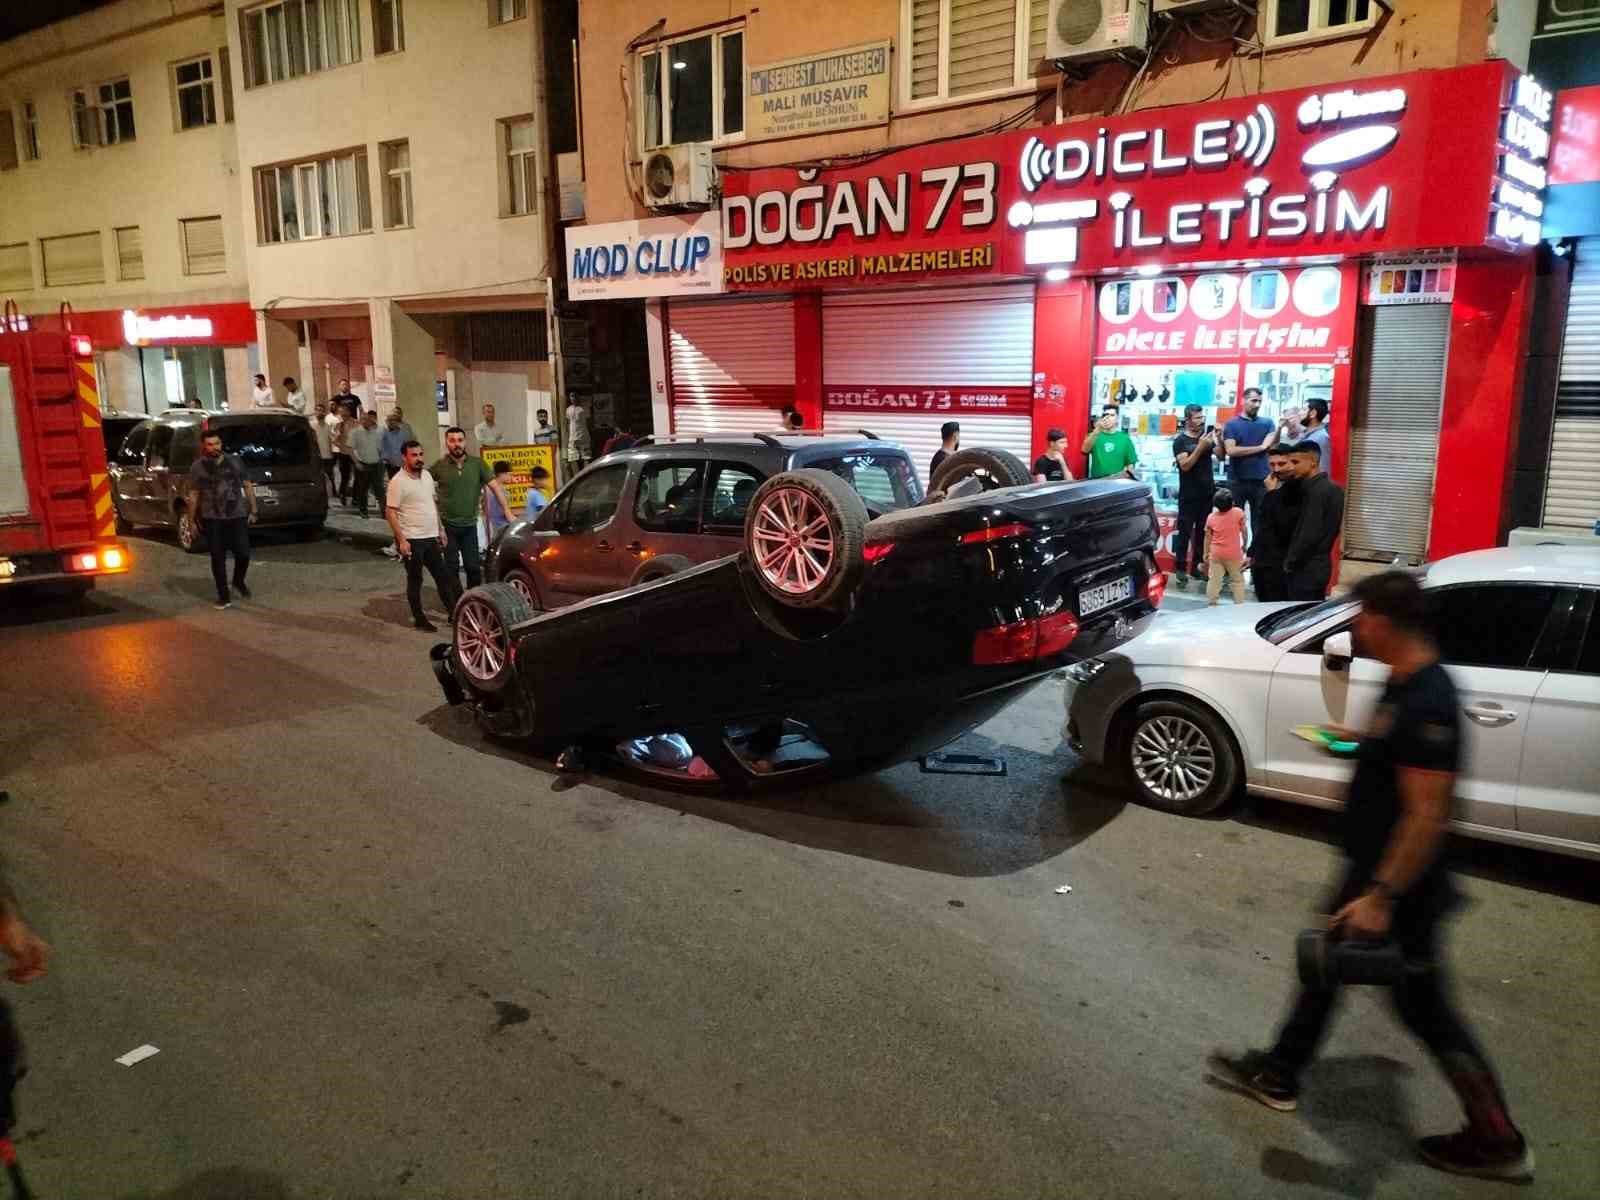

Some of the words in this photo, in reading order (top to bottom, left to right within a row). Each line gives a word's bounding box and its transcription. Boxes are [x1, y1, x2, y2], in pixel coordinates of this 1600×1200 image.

[1055, 120, 1230, 180] DİCLE
[722, 169, 906, 249] DOĞAN
[921, 161, 995, 230] 73
[573, 243, 628, 279] MOD
[636, 235, 711, 275] CLUP
[724, 262, 766, 283] POLİS
[770, 263, 790, 281] VE
[795, 254, 855, 279] ASKERİ
[862, 243, 992, 276] MALZEMELERİ
[1105, 327, 1186, 352] DİCLE
[1193, 321, 1330, 354] İLETİŞİM
[828, 389, 918, 407] DOĞAN
[922, 389, 951, 410] 73
